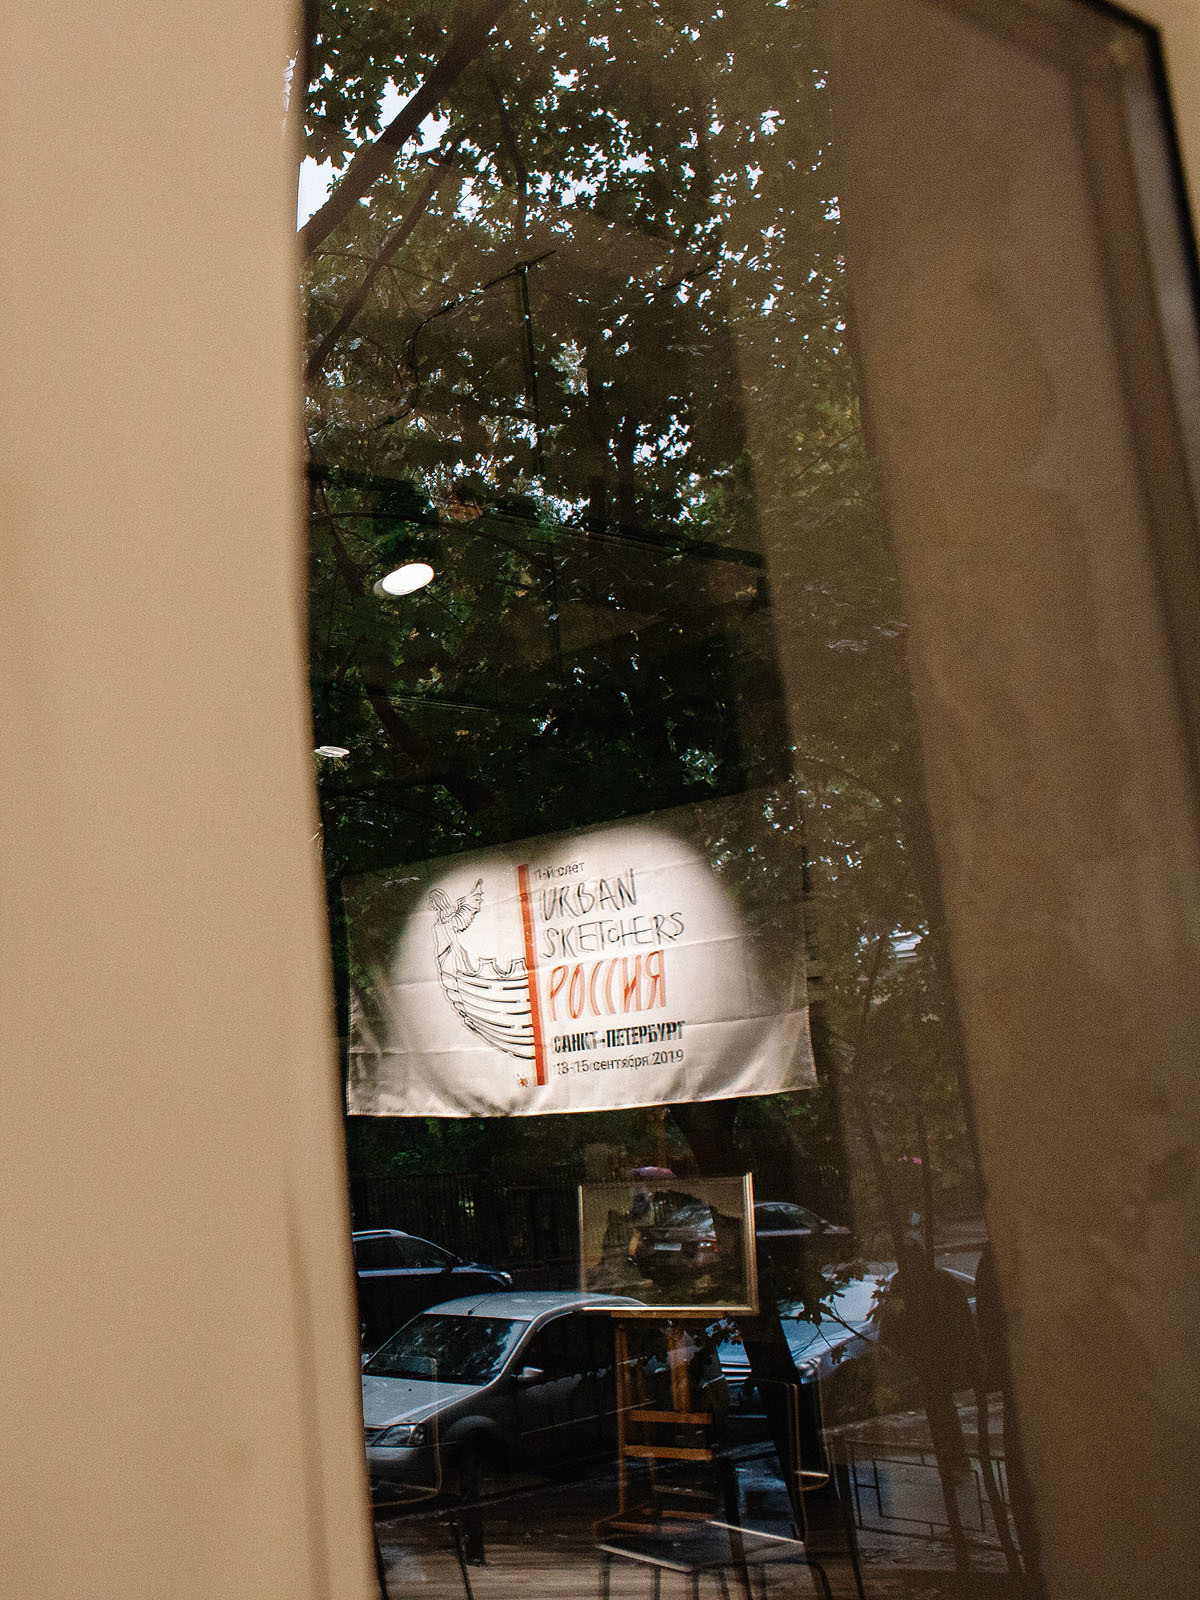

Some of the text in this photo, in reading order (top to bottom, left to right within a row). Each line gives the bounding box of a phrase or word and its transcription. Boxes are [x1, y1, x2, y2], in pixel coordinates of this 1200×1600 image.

[541, 867, 637, 921] URBAN
[541, 911, 685, 958] SKETCHERS
[549, 949, 667, 1022] РОССИЯ
[553, 1020, 686, 1054] САНКТ-ПЕТЕРБУРГ
[555, 1048, 684, 1076] 13-15 сентября 2019
